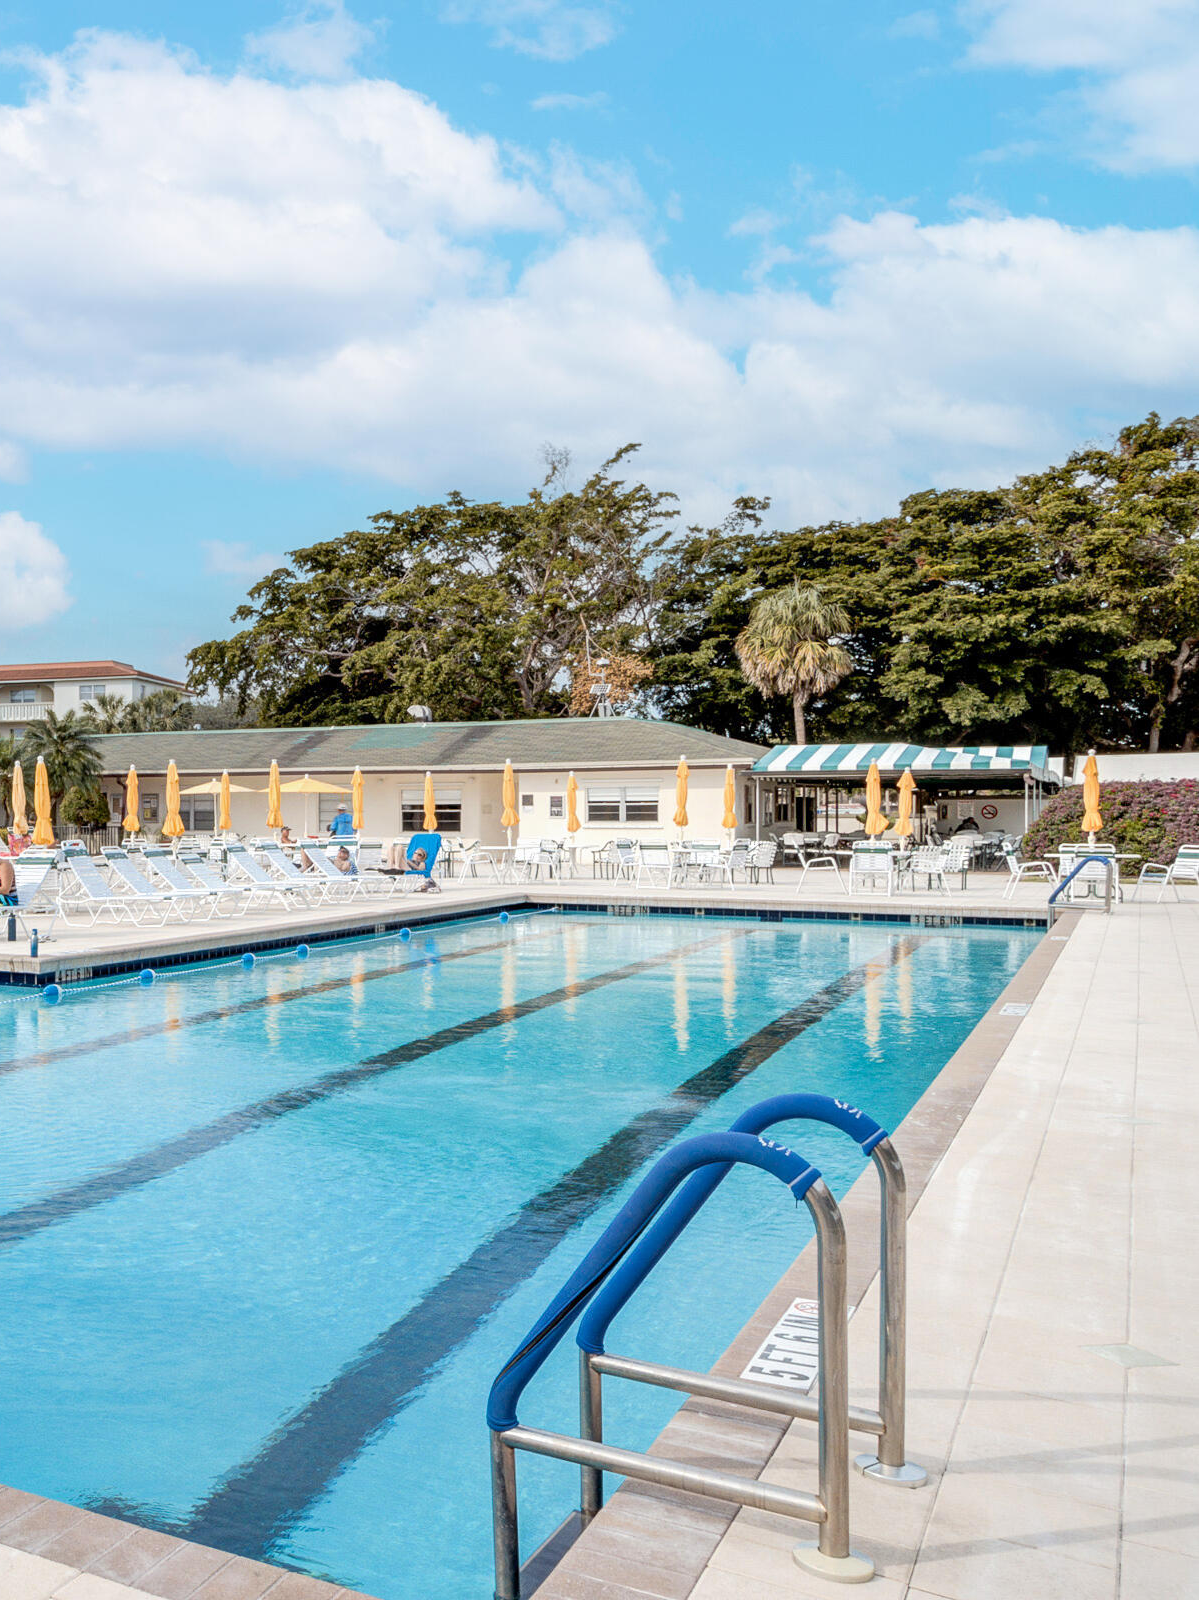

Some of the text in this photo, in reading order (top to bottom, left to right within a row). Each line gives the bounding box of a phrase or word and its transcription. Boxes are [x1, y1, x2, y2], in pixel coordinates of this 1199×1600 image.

[949, 916, 961, 925] IN
[748, 1313, 819, 1381] 5 FT 6 IN
